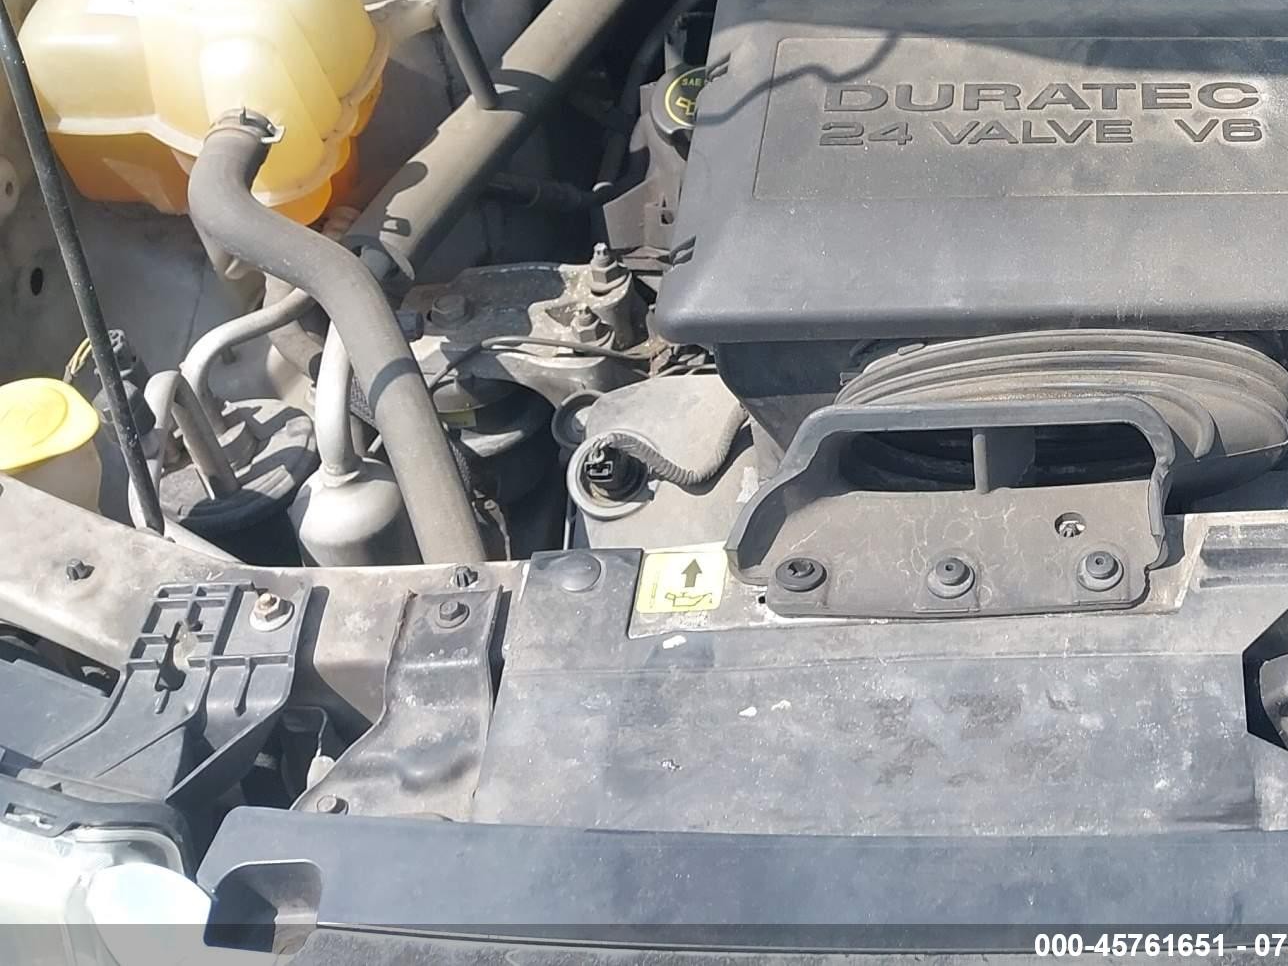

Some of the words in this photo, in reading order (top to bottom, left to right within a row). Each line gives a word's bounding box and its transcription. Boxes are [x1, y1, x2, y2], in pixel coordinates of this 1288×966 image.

[681, 77, 702, 87] SAE
[823, 81, 1260, 113] DURATEC
[818, 120, 914, 147] 24
[932, 119, 1133, 145] VALVE
[1173, 118, 1265, 144] V6
